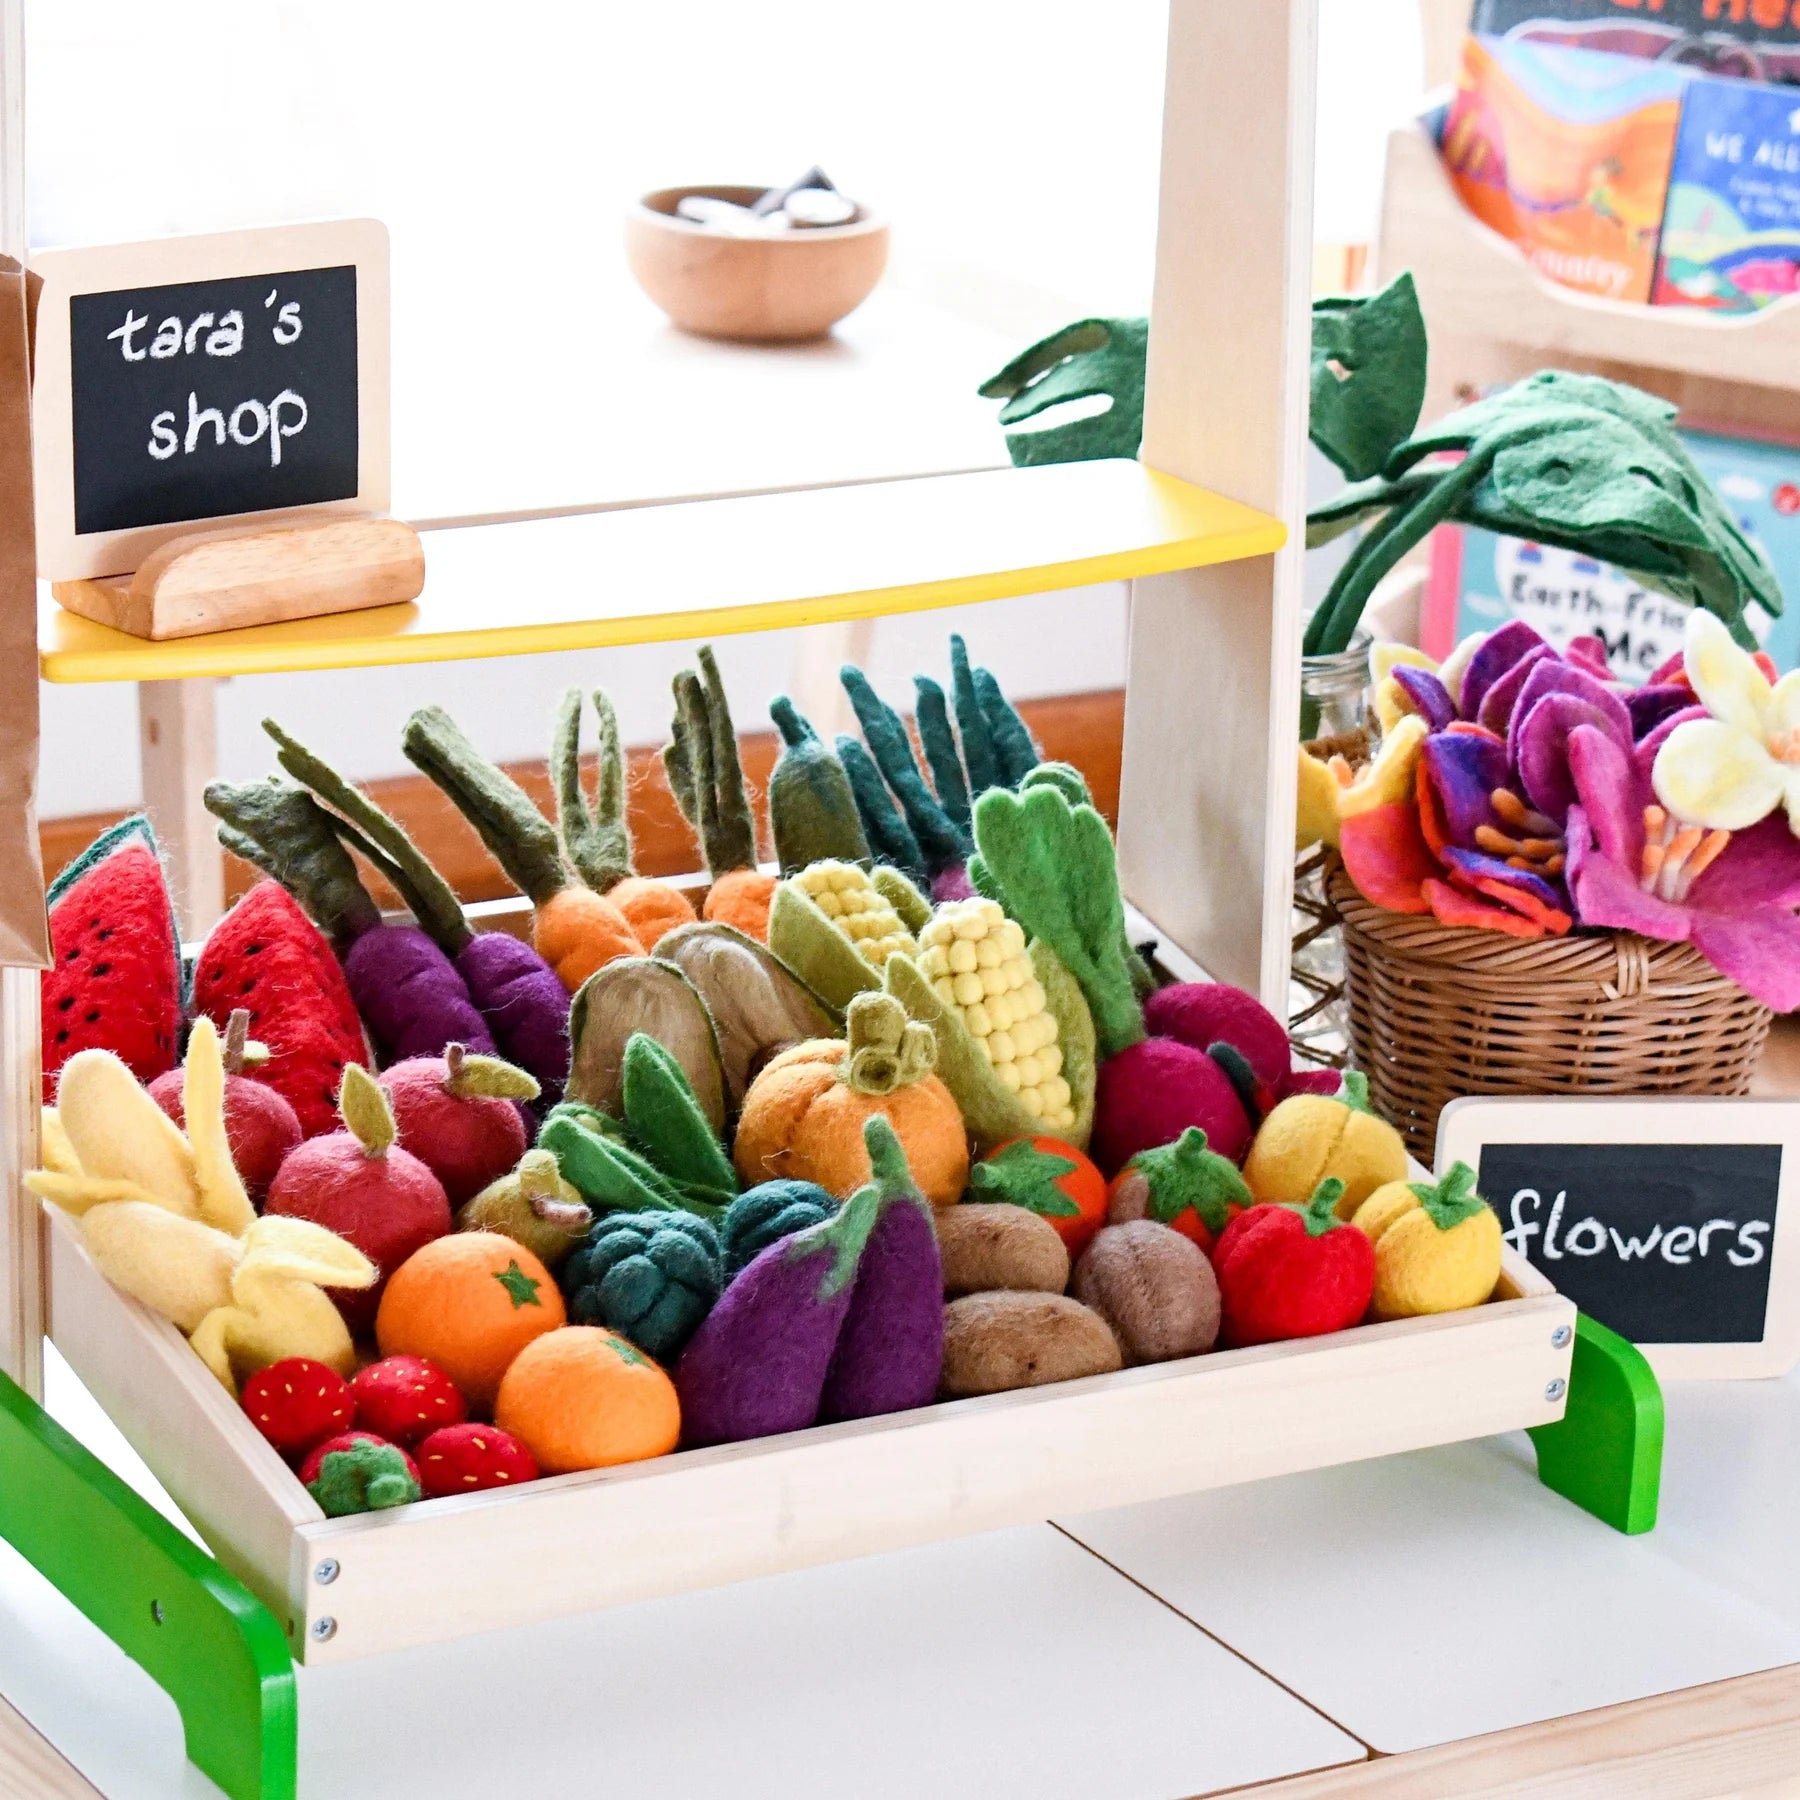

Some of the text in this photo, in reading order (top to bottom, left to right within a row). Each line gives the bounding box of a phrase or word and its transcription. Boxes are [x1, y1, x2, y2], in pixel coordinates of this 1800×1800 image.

[148, 388, 308, 467] shop
[1593, 626, 1658, 670] Me
[1502, 1188, 1770, 1267] flowers
